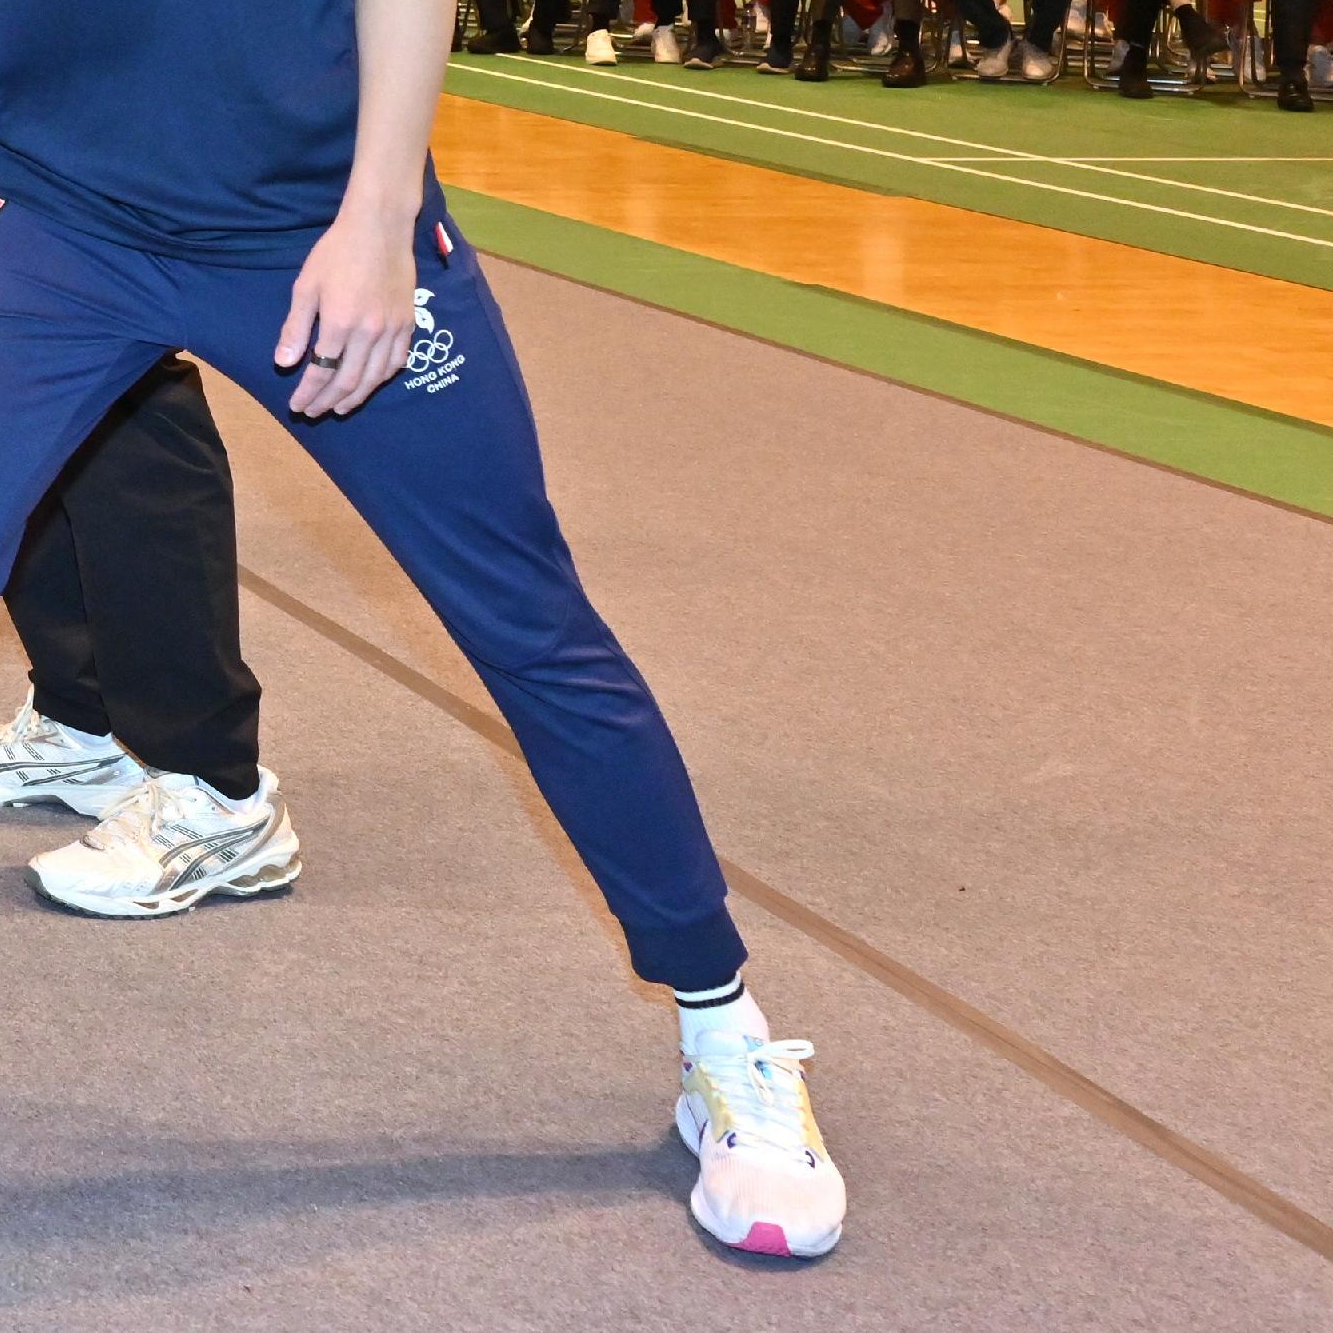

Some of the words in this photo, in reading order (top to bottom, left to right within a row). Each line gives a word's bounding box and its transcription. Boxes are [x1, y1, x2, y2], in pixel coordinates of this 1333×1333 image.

[404, 371, 437, 389] HONG
[437, 354, 465, 376] KONG
[426, 374, 459, 393] CHINA
